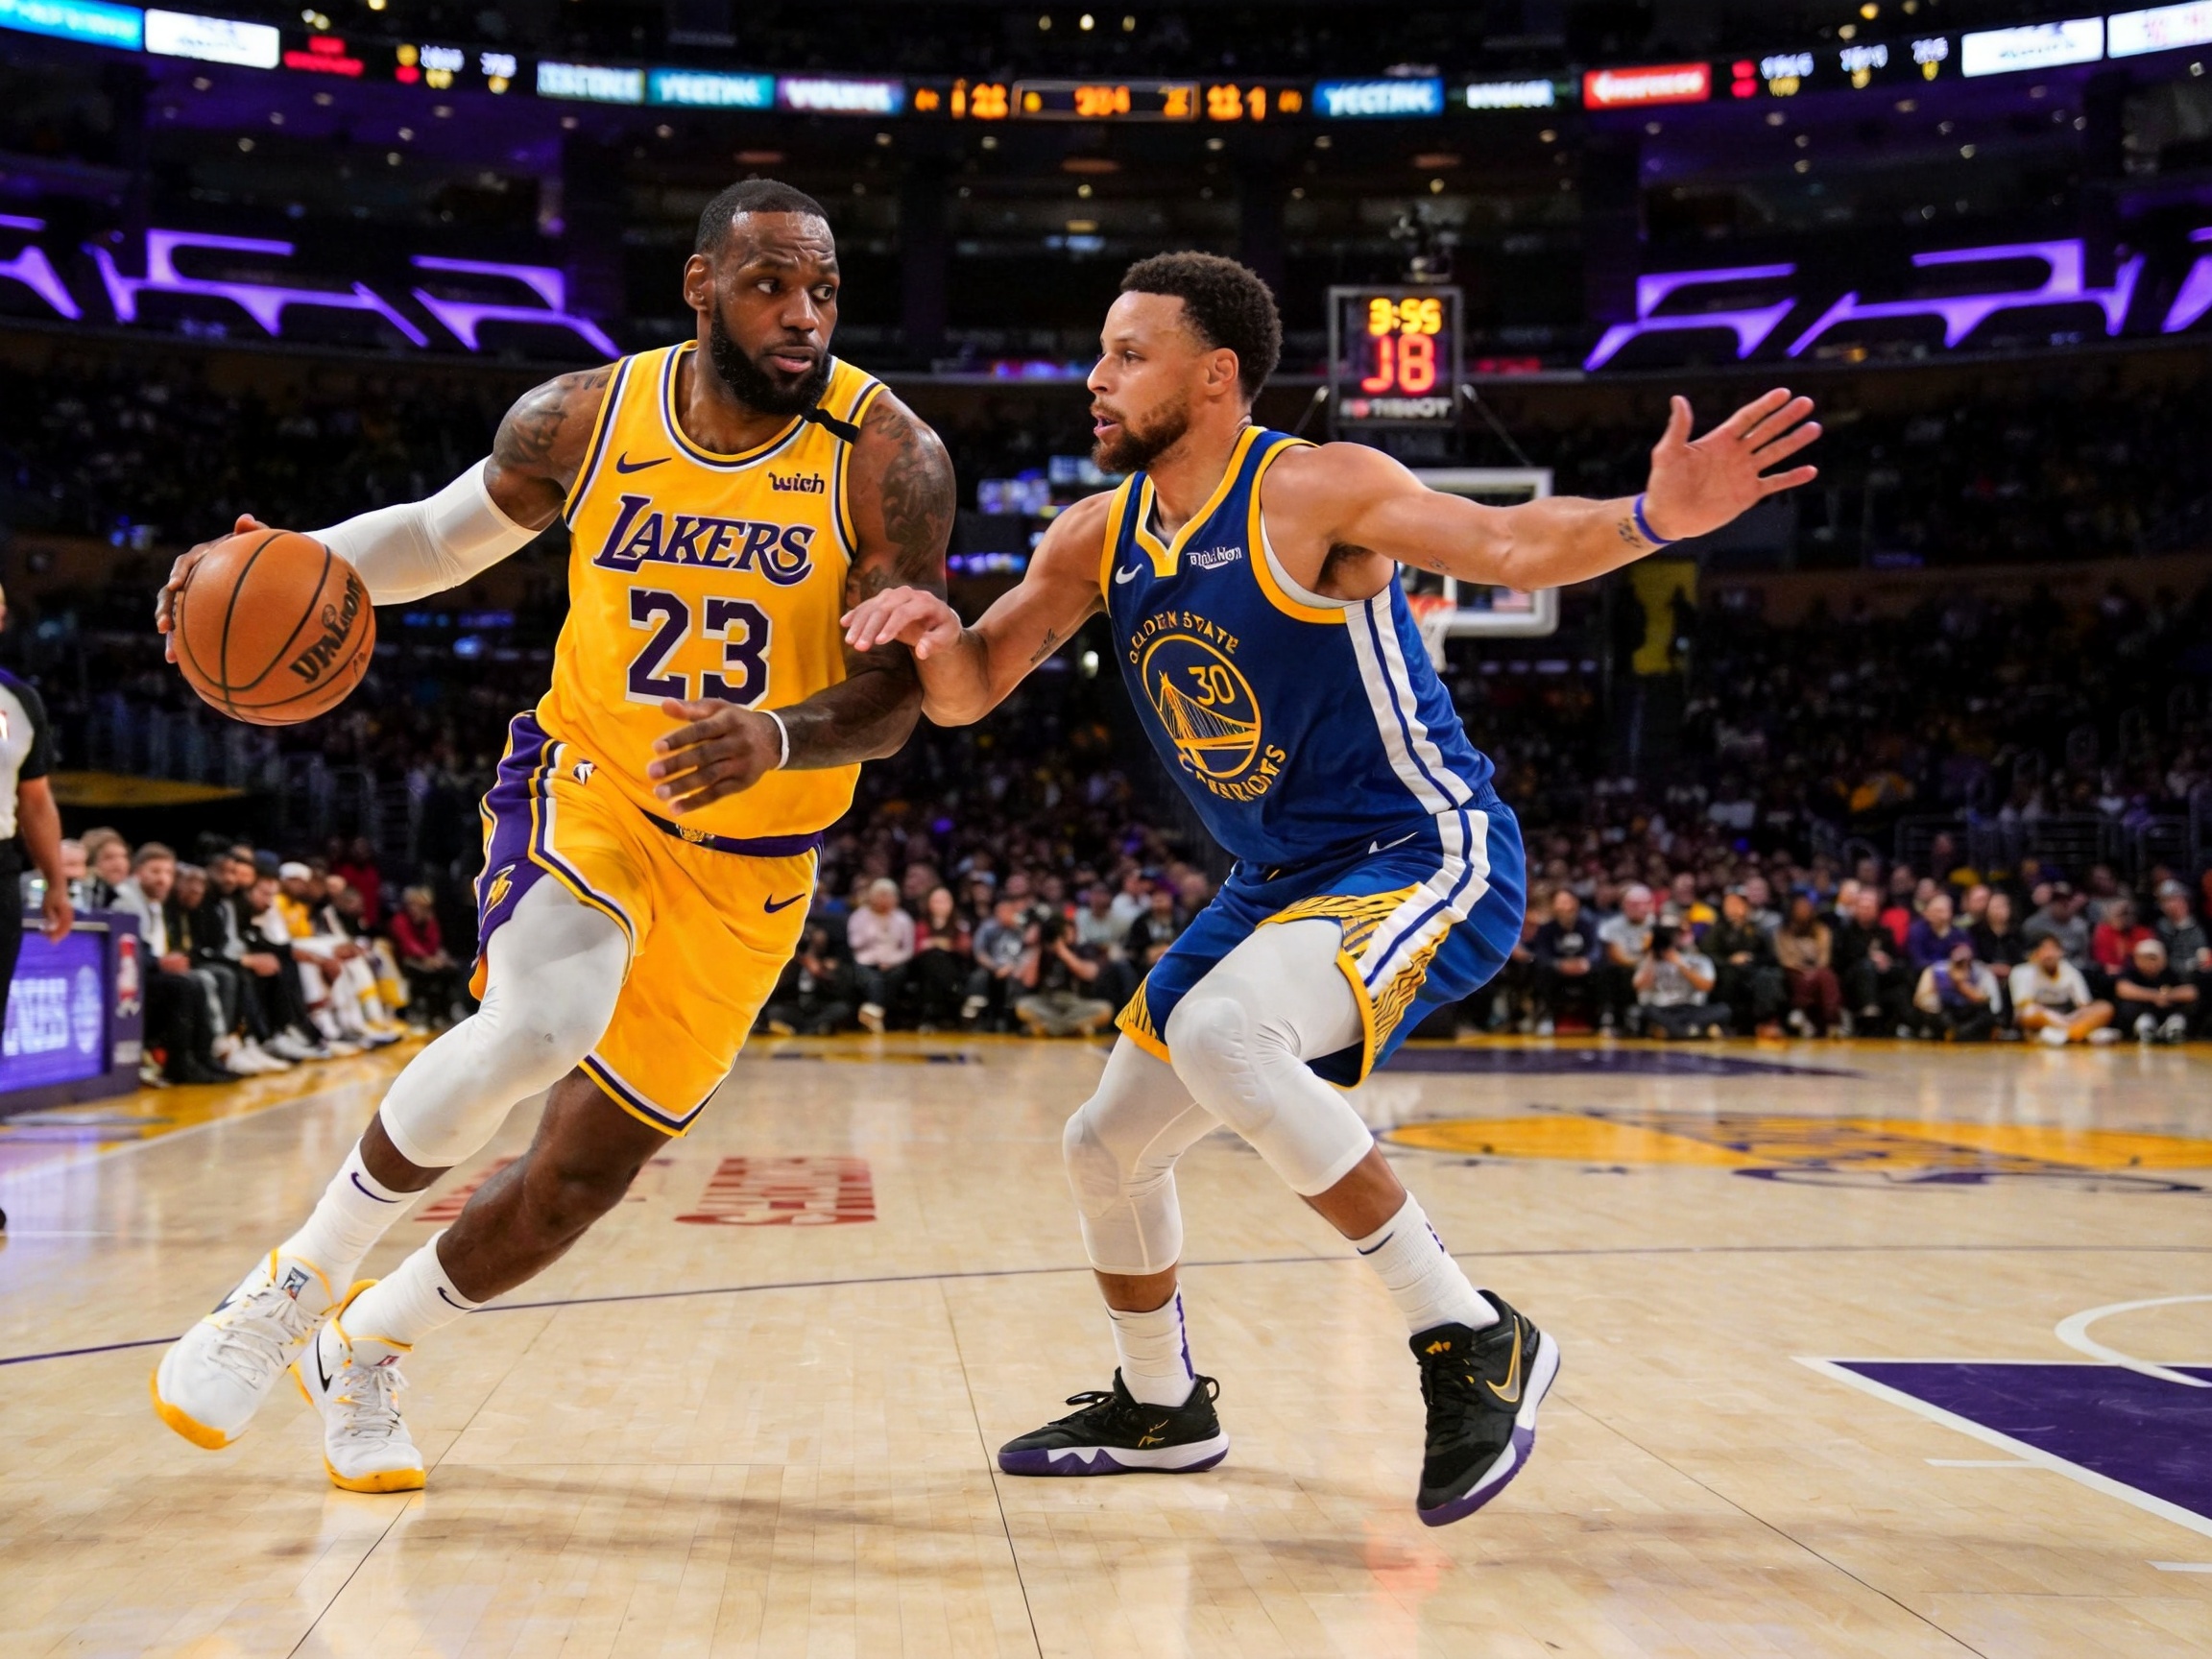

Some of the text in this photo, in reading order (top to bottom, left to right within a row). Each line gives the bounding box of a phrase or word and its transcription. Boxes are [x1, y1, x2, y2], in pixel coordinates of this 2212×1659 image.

[590, 492, 818, 588] LAKERS
[625, 585, 773, 712] 23
[1188, 663, 1237, 707] 30
